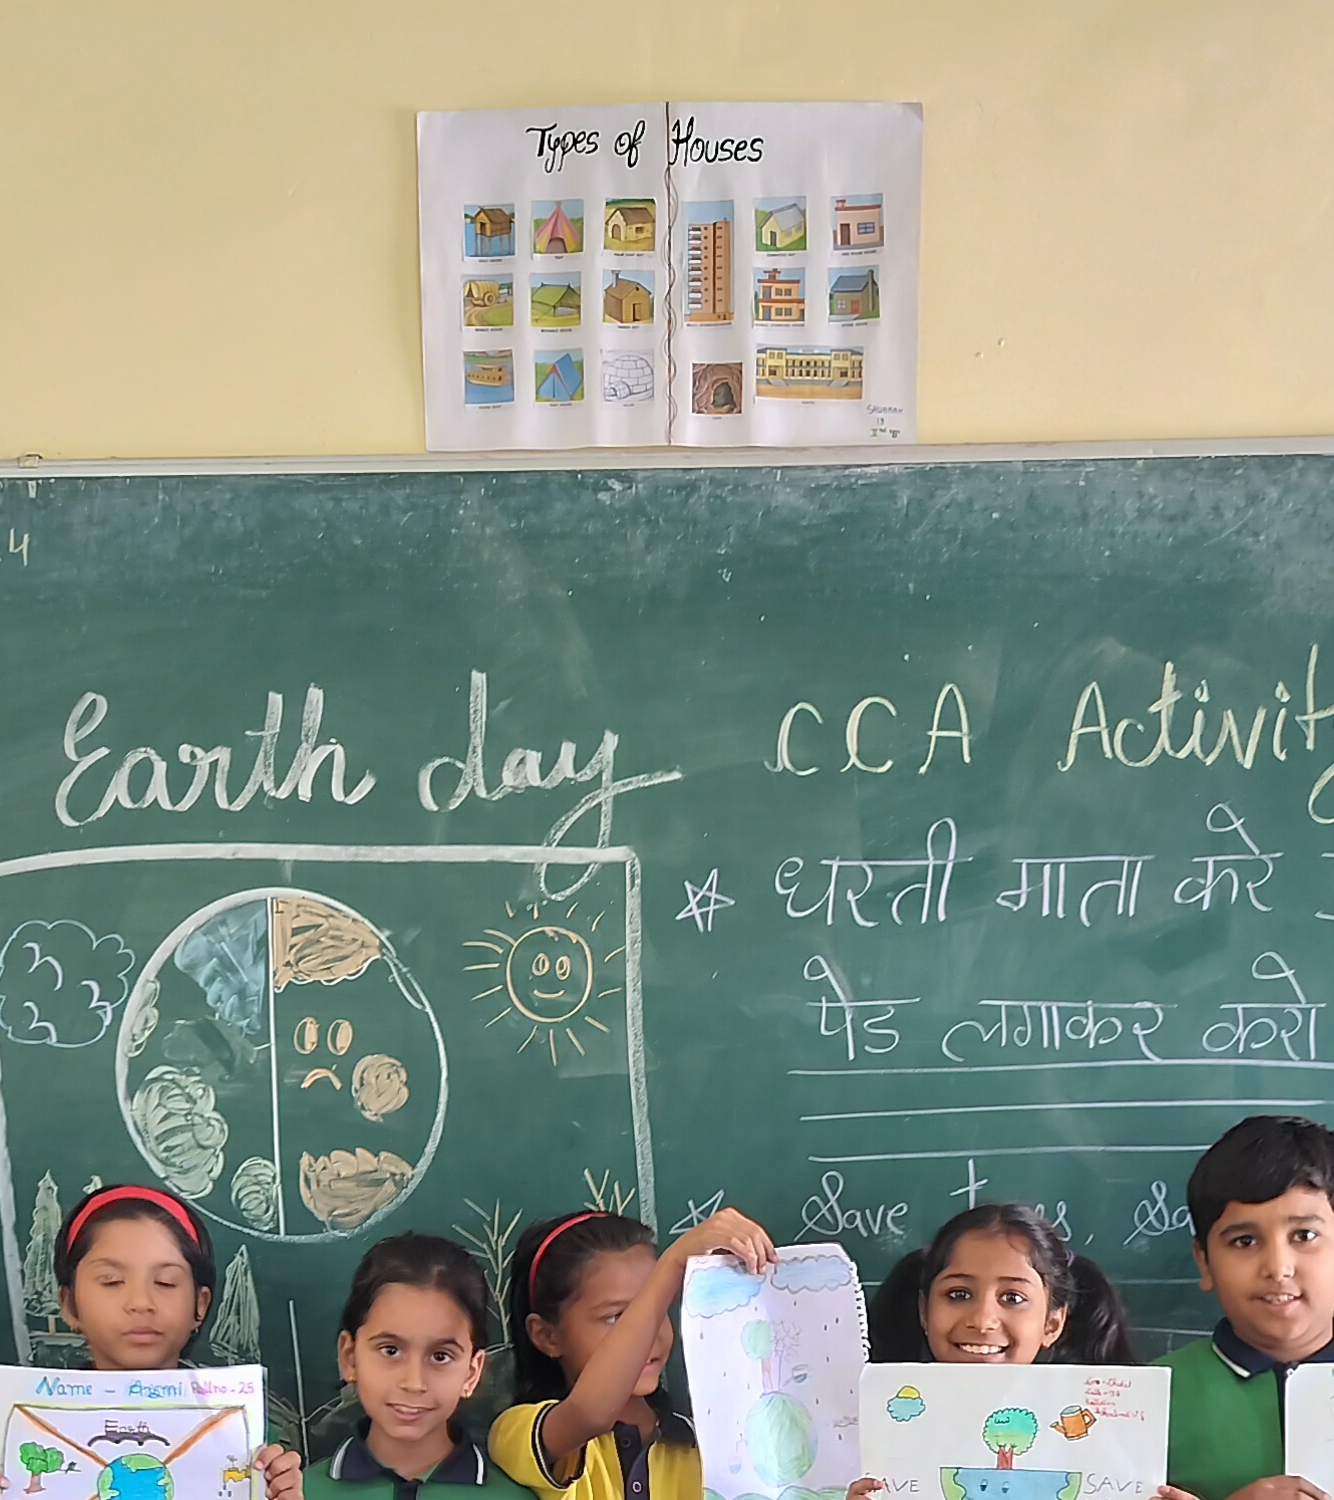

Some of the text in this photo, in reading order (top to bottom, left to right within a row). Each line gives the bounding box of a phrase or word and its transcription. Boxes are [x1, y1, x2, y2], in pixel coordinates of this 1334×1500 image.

[526, 116, 764, 173] Types of Houses
[55, 683, 378, 828] Earth
[419, 668, 681, 901] day
[775, 817, 974, 928] धरती
[1173, 803, 1285, 913] करे
[941, 1001, 1177, 1062] लगाकर
[1201, 951, 1328, 1061] करो
[794, 1169, 909, 1243] Save
[34, 1376, 93, 1397] Name
[1082, 1473, 1144, 1495] SAVE
